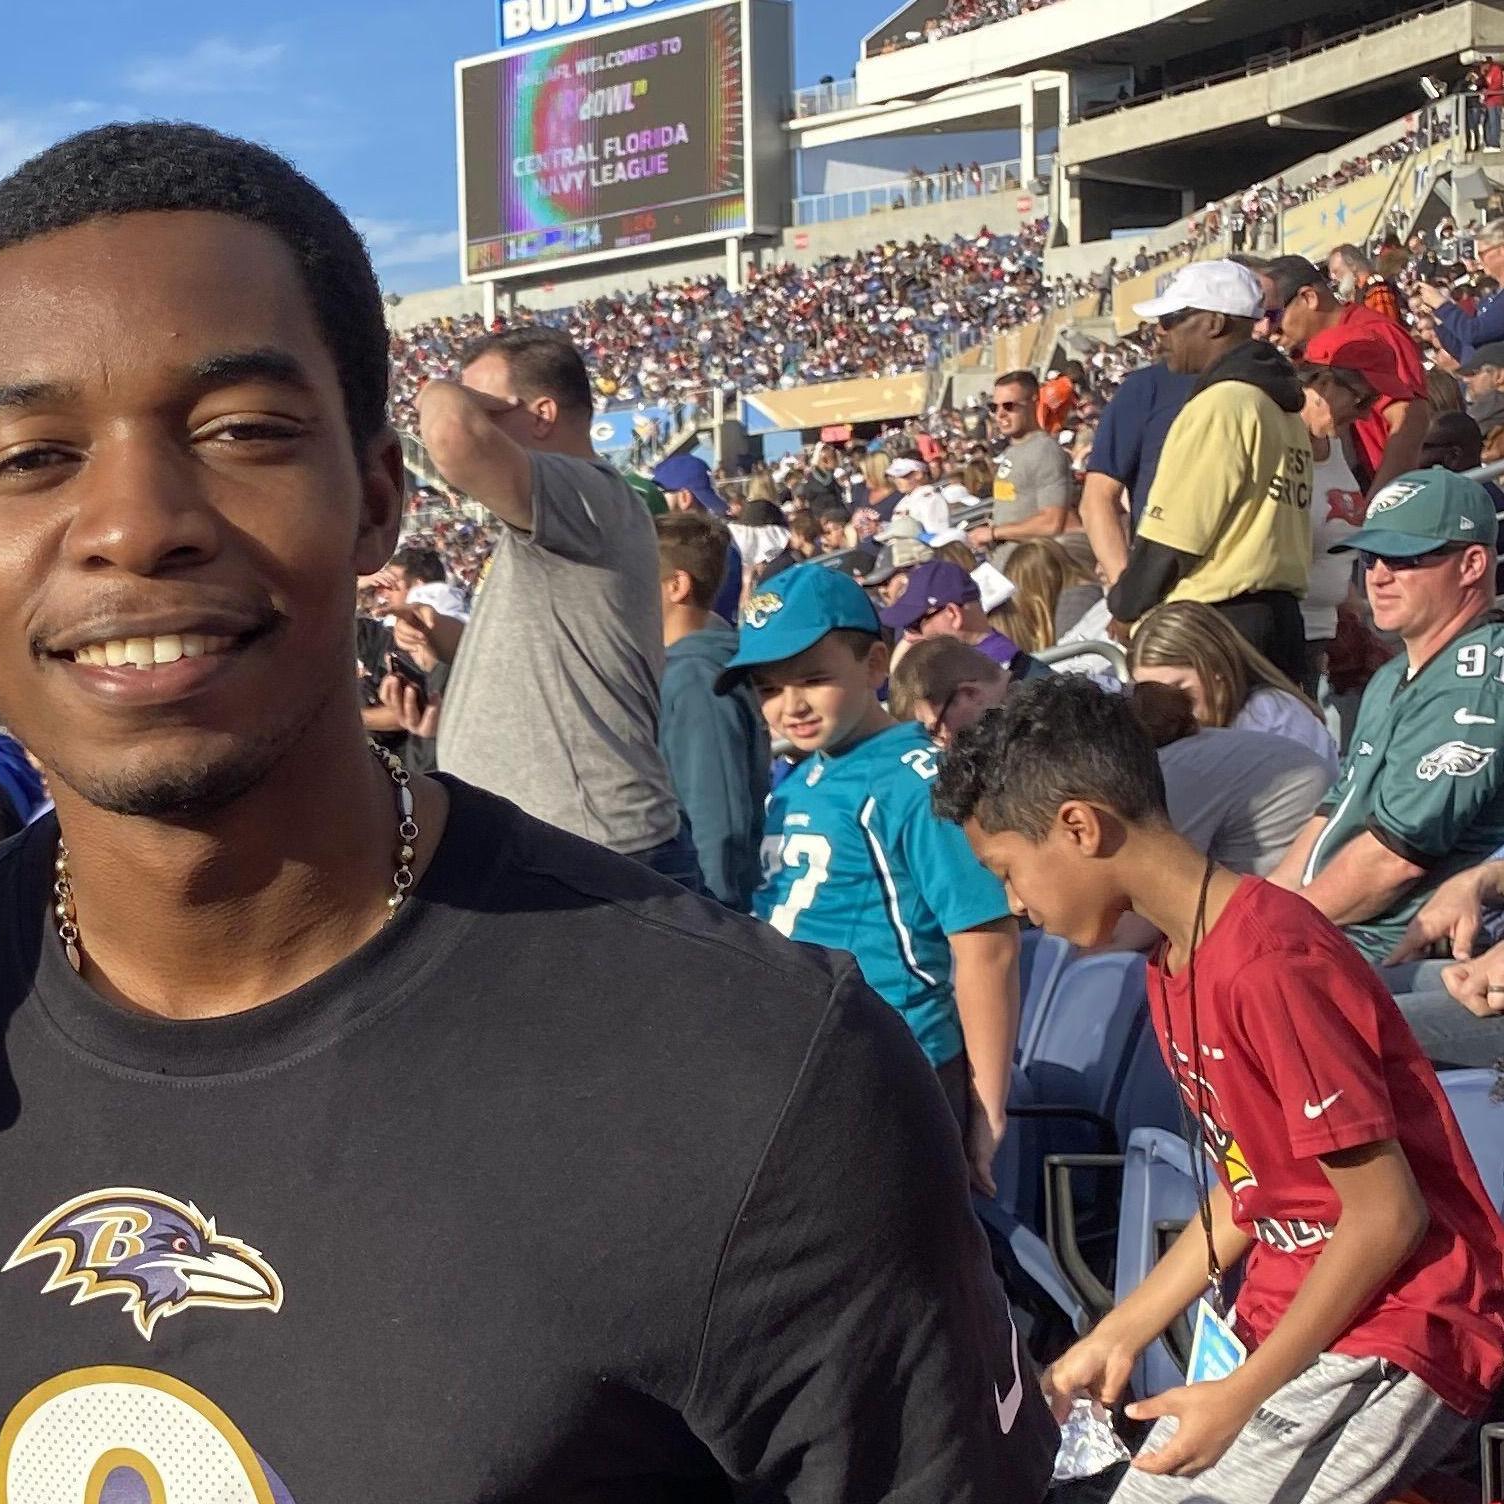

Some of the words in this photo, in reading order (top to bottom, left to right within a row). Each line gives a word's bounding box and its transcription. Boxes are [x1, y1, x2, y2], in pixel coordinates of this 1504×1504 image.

[661, 36, 683, 57] TO
[602, 121, 690, 159] FLORIDA
[589, 153, 670, 188] LEAGUE
[900, 747, 939, 780] 2
[73, 1206, 153, 1267] B
